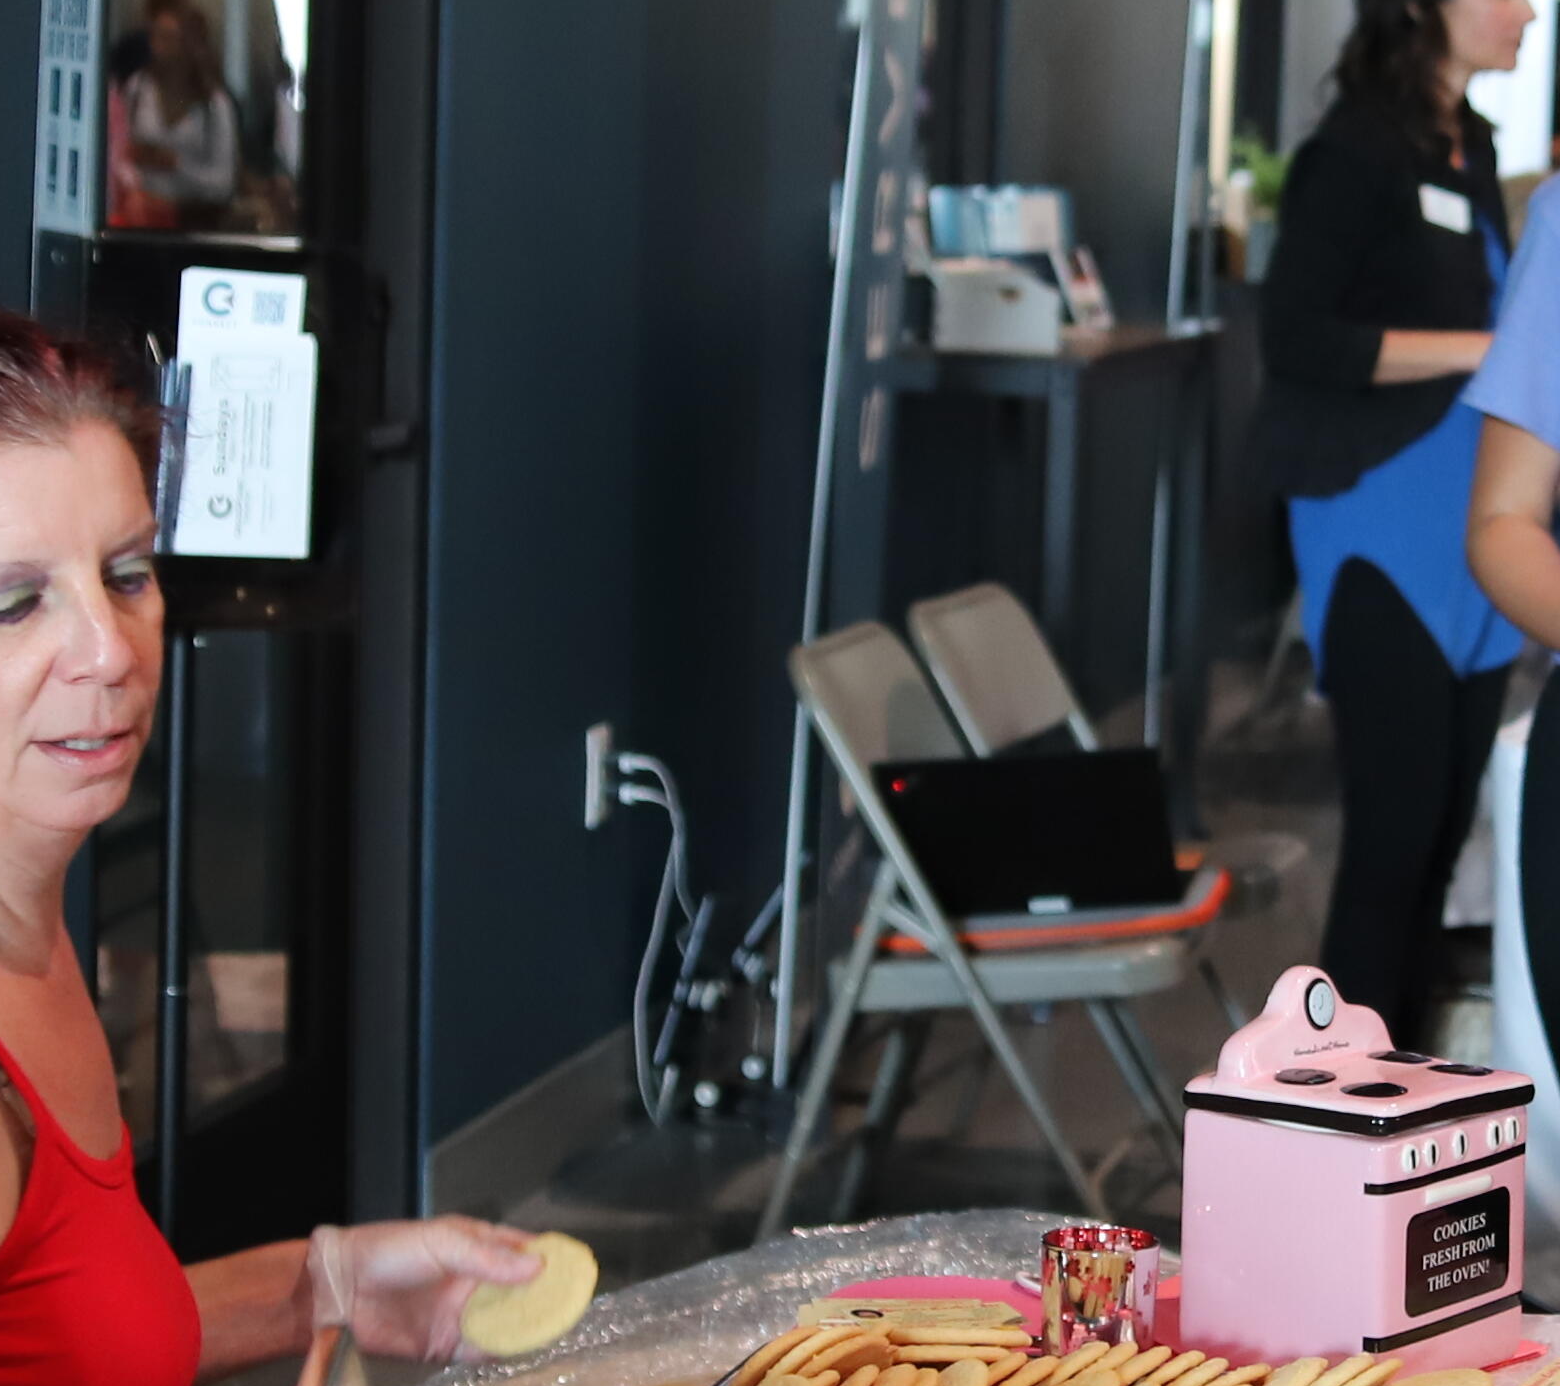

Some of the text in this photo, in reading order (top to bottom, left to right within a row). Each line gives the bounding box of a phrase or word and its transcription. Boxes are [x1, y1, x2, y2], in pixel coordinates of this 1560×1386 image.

[1433, 1212, 1487, 1243] COOKIES
[1422, 1233, 1496, 1271] FRESH FROM
[1427, 1258, 1491, 1293] THE OVEN!
